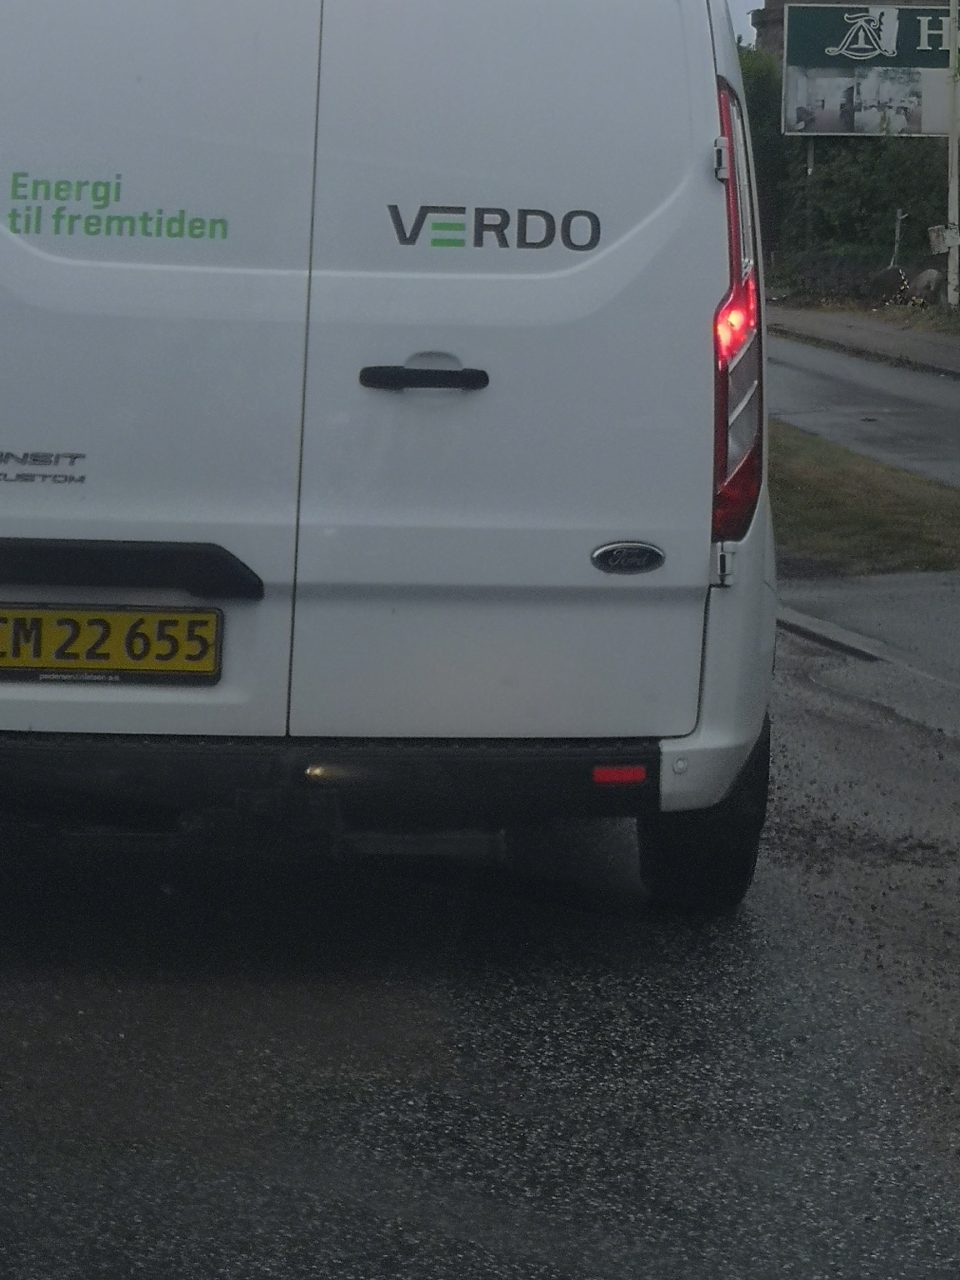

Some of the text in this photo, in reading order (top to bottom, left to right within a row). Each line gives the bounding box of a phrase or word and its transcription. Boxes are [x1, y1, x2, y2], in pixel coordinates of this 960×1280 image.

[10, 172, 122, 209] Energi
[8, 206, 228, 239] til fremtiden
[387, 204, 601, 252] VERDO
[0, 452, 86, 466] NSIT
[0, 473, 86, 484] USTOM
[54, 618, 111, 661] 22
[125, 618, 209, 661] 655
